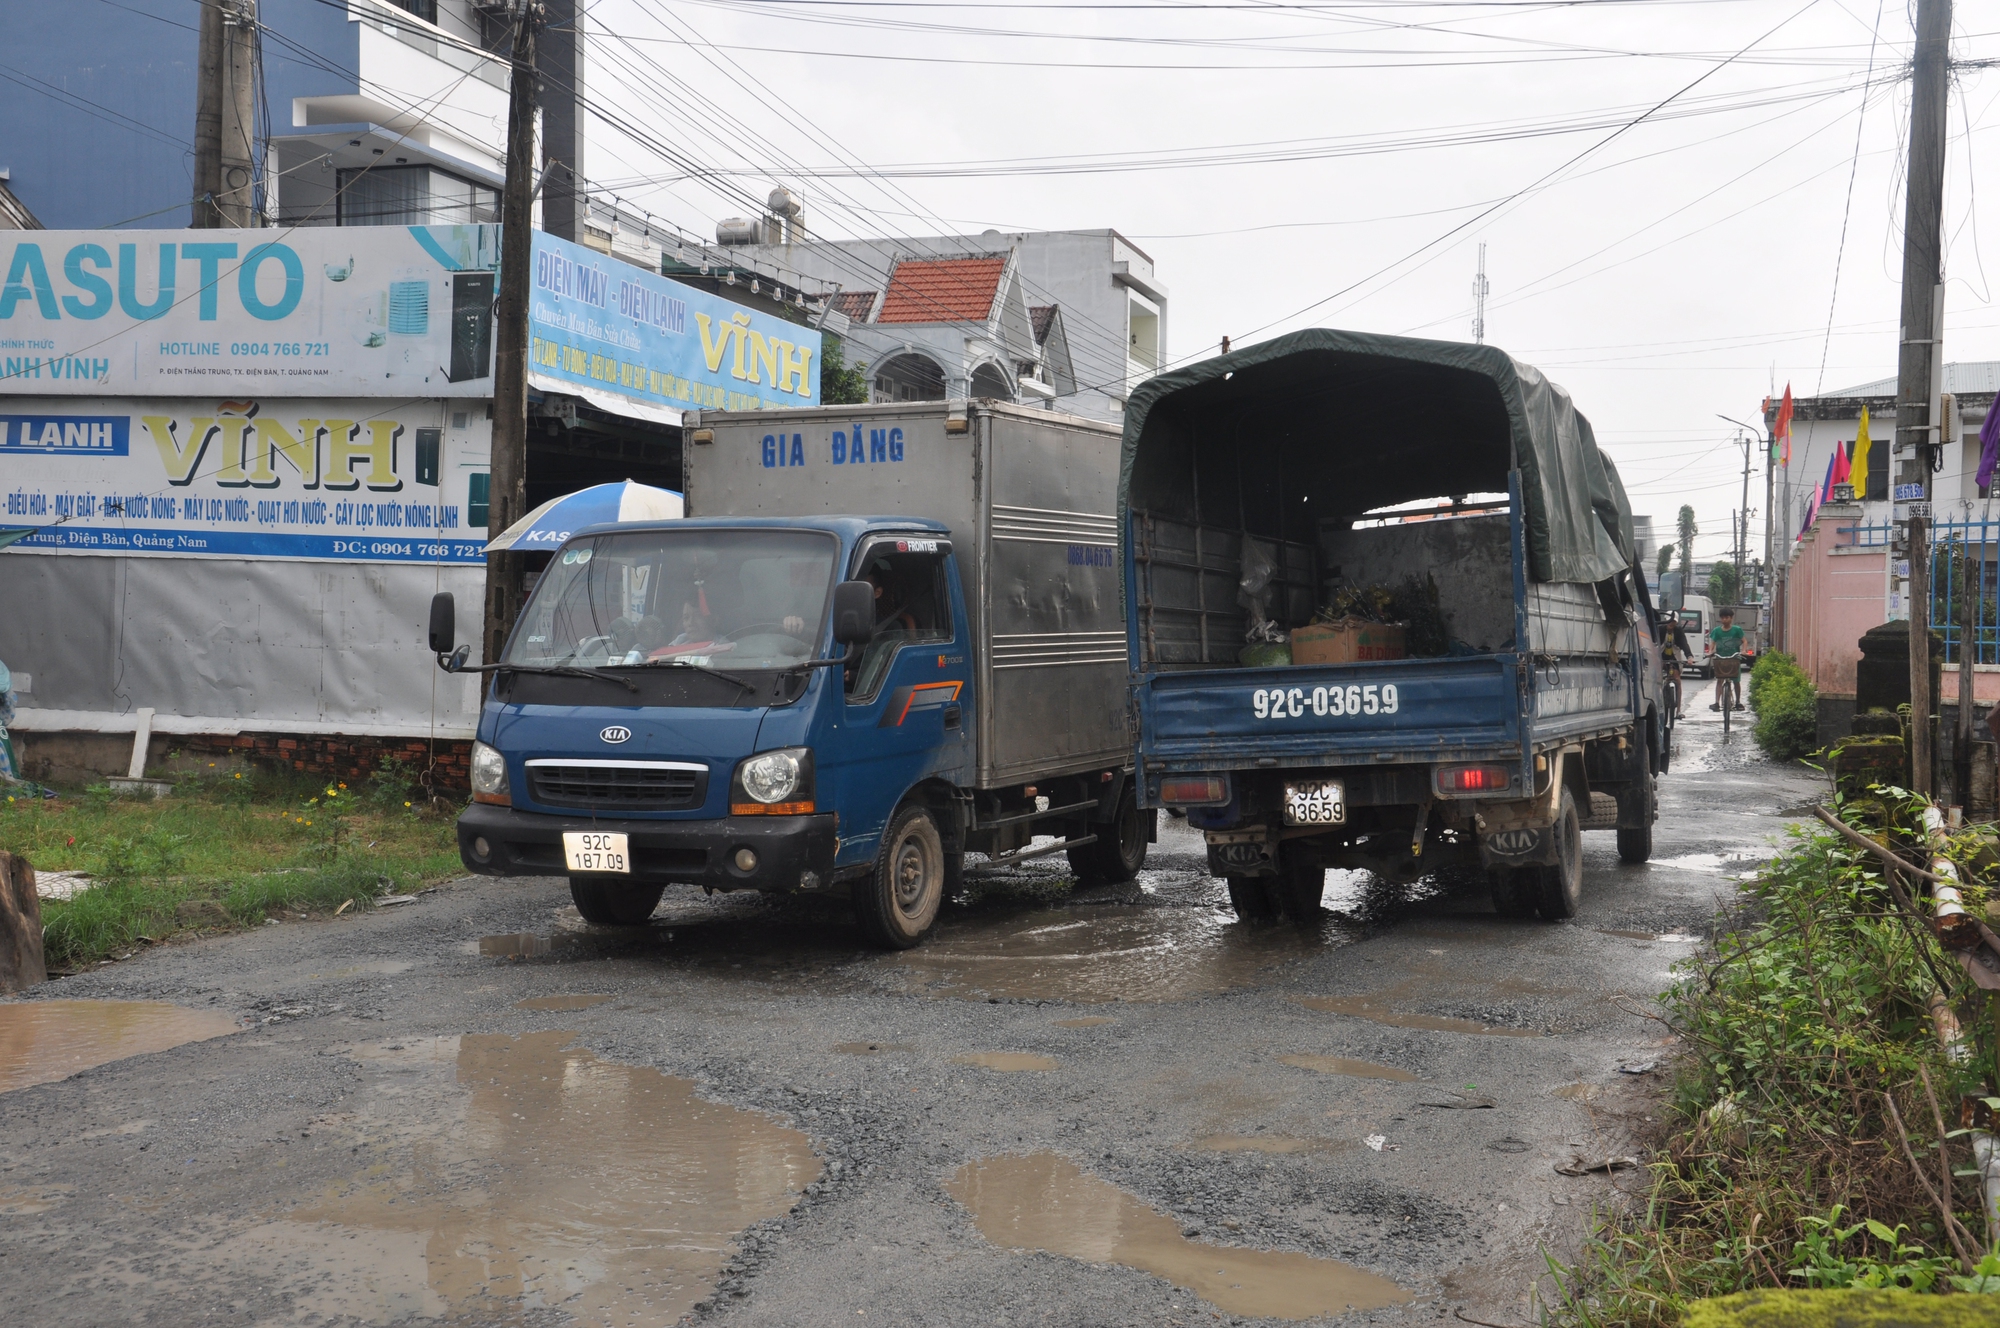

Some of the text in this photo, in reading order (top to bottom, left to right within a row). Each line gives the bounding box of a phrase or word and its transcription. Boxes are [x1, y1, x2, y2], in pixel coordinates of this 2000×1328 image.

[0, 242, 304, 321] ASUTO
[537, 248, 686, 336] ĐIỆN MÁY ĐIỆN LẠNH
[535, 301, 567, 327] Chuyên
[568, 312, 585, 334] Mua
[587, 318, 603, 338] Bán
[604, 323, 619, 344] Sửa
[0, 338, 55, 350] HÍNH THỨC
[160, 342, 329, 356] HOTLINE 0904 766 721
[695, 311, 813, 398] VĨNH
[0, 352, 109, 379] NH VĨNH
[167, 367, 183, 376] ĐIỆN
[208, 368, 232, 376] TRUNG,
[246, 367, 262, 377] ĐIỆN
[264, 367, 279, 376] BÀN,
[288, 367, 312, 376] QUẢNG
[20, 422, 113, 451] LẠNH
[141, 400, 403, 491] VĨNH
[762, 423, 904, 468] GIA ĐĂNG
[29, 489, 47, 516] HÒA
[55, 490, 75, 516] MÁY
[76, 491, 96, 522] GIẶT
[104, 492, 123, 518] MÁY
[125, 492, 149, 518] NƯỚC
[151, 493, 175, 519] NÓNG
[184, 494, 203, 520] MÁY
[206, 499, 222, 526] LỌC
[225, 495, 249, 522] NƯỚC
[258, 500, 281, 528] QUẠT
[283, 498, 299, 524] HƠI
[301, 499, 327, 525] NƯỚC
[335, 498, 353, 526] CÂY
[356, 503, 374, 531] LỌC
[376, 500, 402, 528] NƯỚC
[405, 501, 431, 528] NÓNG
[433, 505, 458, 533] LẠNH
[69, 532, 98, 547] Điện
[102, 533, 130, 547] Bàn,
[133, 535, 174, 549] Quảng
[177, 535, 207, 548] Nam
[526, 530, 573, 542] KAS
[333, 541, 367, 554] ĐC:
[371, 542, 412, 556] 0904
[417, 543, 449, 556] 766
[907, 540, 938, 552] FRONTIER
[1357, 646, 1373, 660] BA
[1253, 684, 1399, 719] 92C-0365.9
[604, 729, 626, 740] KIA
[1298, 782, 1329, 801] 92C
[1287, 802, 1343, 822] 036.59
[582, 835, 612, 850] 92C
[1495, 830, 1532, 849] KIA
[575, 853, 624, 870] 187.09
[1226, 846, 1260, 861] KIA
